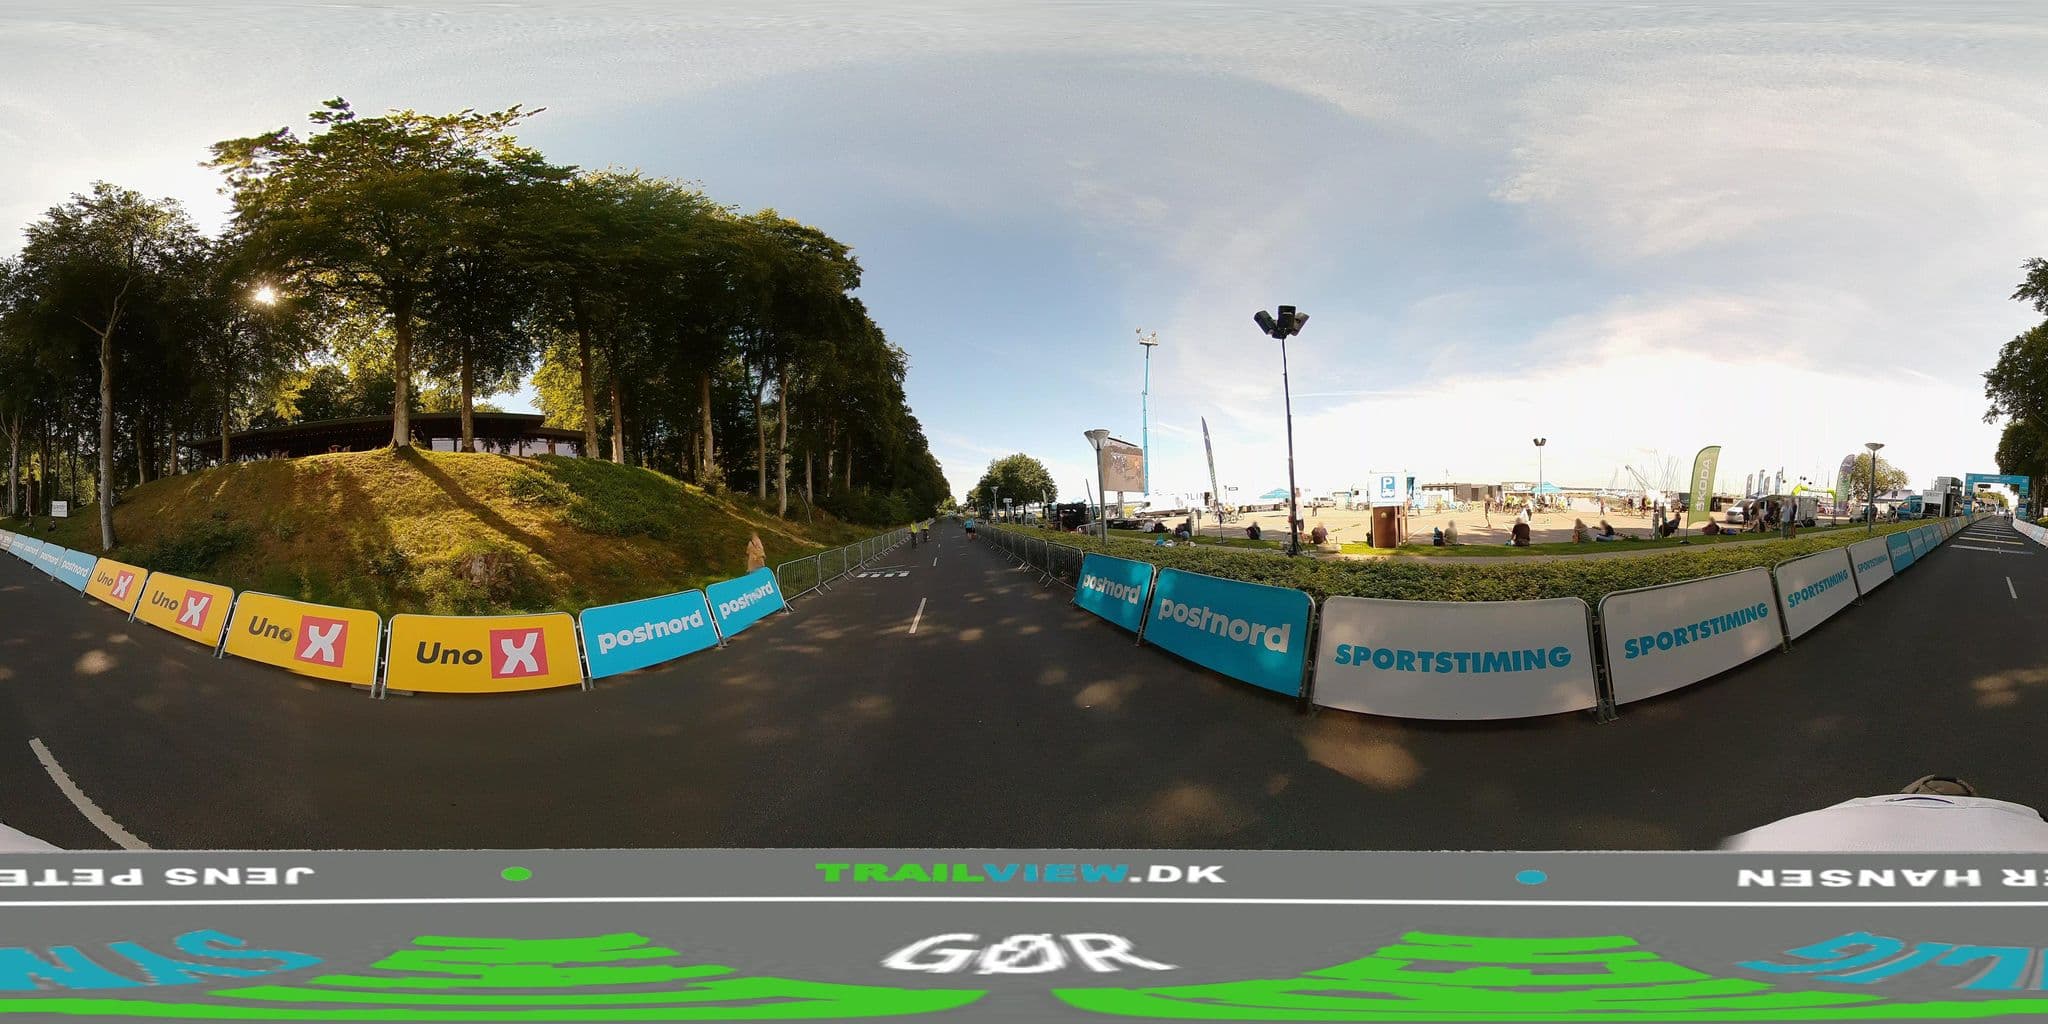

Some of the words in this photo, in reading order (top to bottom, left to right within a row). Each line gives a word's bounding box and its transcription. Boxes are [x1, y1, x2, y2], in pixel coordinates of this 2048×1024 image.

[1382, 477, 1393, 489] P
[39, 551, 60, 566] postnord
[61, 559, 90, 577] postnord
[1856, 553, 1888, 574] SPORTSTIMING
[96, 570, 113, 587] Uno
[114, 574, 134, 599] X
[719, 581, 774, 620] postnord
[1082, 571, 1142, 605] postnord
[1786, 568, 1849, 609] SPORTSTIMING
[151, 590, 179, 611] Uno
[180, 596, 210, 627] X
[1158, 596, 1292, 654] postnord
[248, 614, 293, 643] Uno
[300, 621, 343, 664] X
[598, 610, 704, 654] postnord
[1623, 602, 1769, 660] SPORTSTIMING
[416, 640, 483, 666] Uno
[499, 631, 540, 675] X
[1334, 642, 1573, 675] SPORTSTIMING
